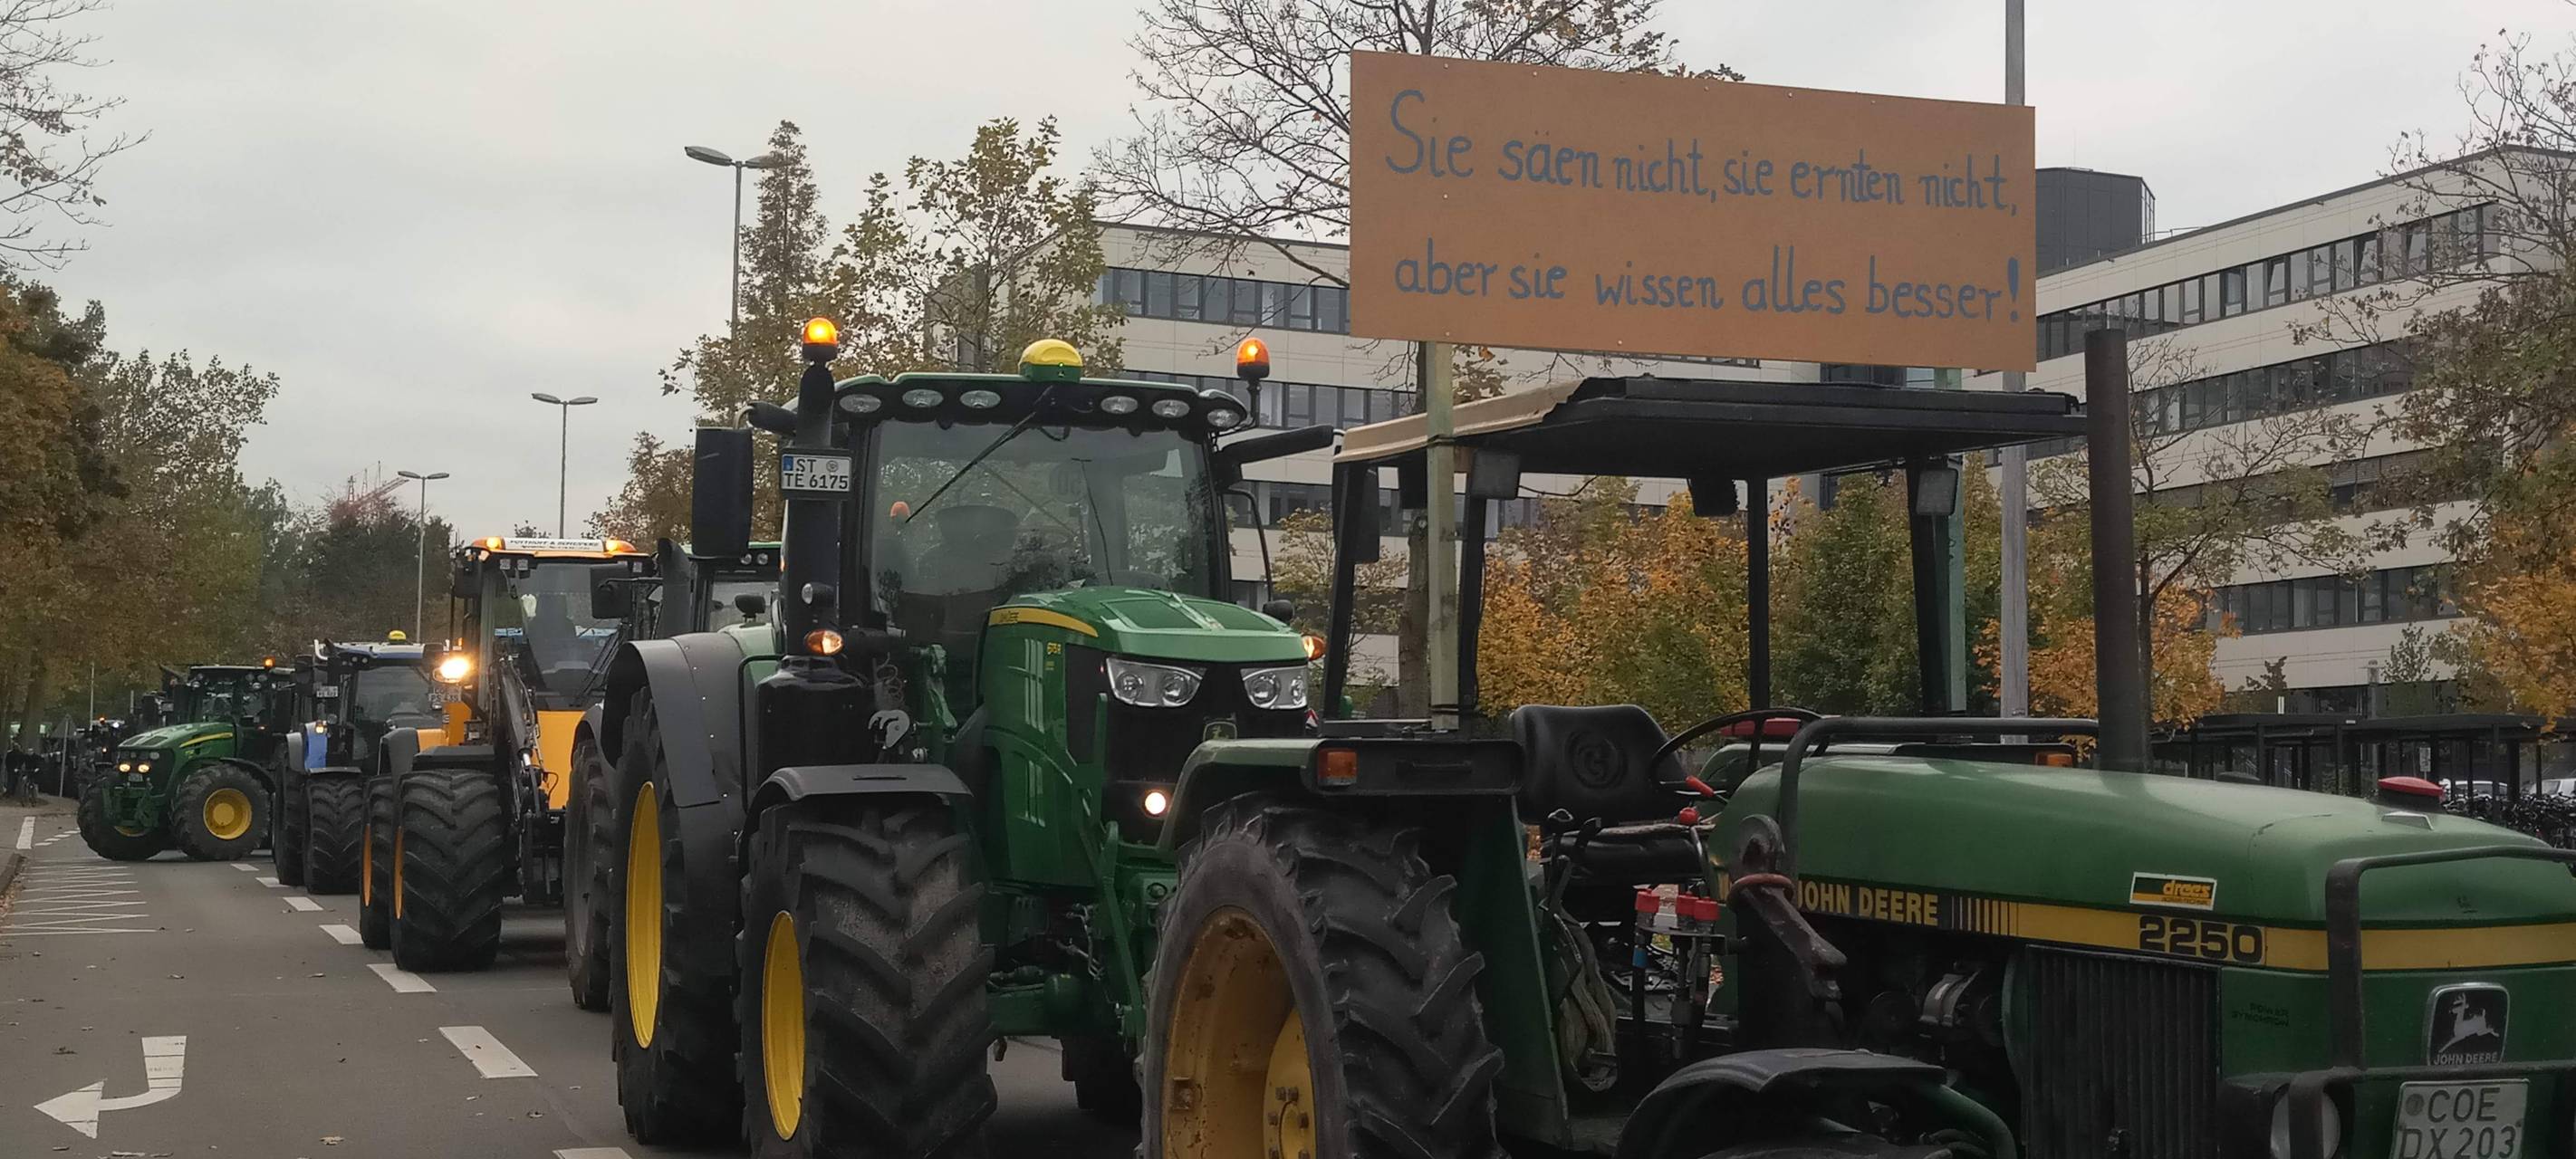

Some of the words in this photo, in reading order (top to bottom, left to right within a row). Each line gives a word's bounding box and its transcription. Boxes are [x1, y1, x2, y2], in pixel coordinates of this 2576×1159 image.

[1385, 90, 1474, 177] Sie
[1497, 129, 1603, 188] säen
[1612, 138, 1716, 204] nicht,
[1723, 149, 1774, 196] sie
[1790, 148, 1905, 205] ernten
[1918, 153, 2018, 216] nicht,
[1394, 237, 1498, 297] aber
[1508, 252, 1567, 300] sie
[1594, 261, 1724, 310] wissen
[1742, 244, 1847, 314] alles
[1865, 254, 2020, 323] besser!
[784, 473, 804, 487] TE
[809, 474, 849, 490] 6175
[795, 458, 817, 474] ST
[1797, 880, 1850, 915] JOHN
[1859, 886, 1939, 926] DEERE
[2139, 915, 2263, 963] 2250
[2434, 1054, 2464, 1066] JOHN
[2465, 1051, 2498, 1064] DEERE
[2427, 1087, 2501, 1124] COE
[2399, 1128, 2448, 1159] DX
[2455, 1125, 2516, 1159] 203
